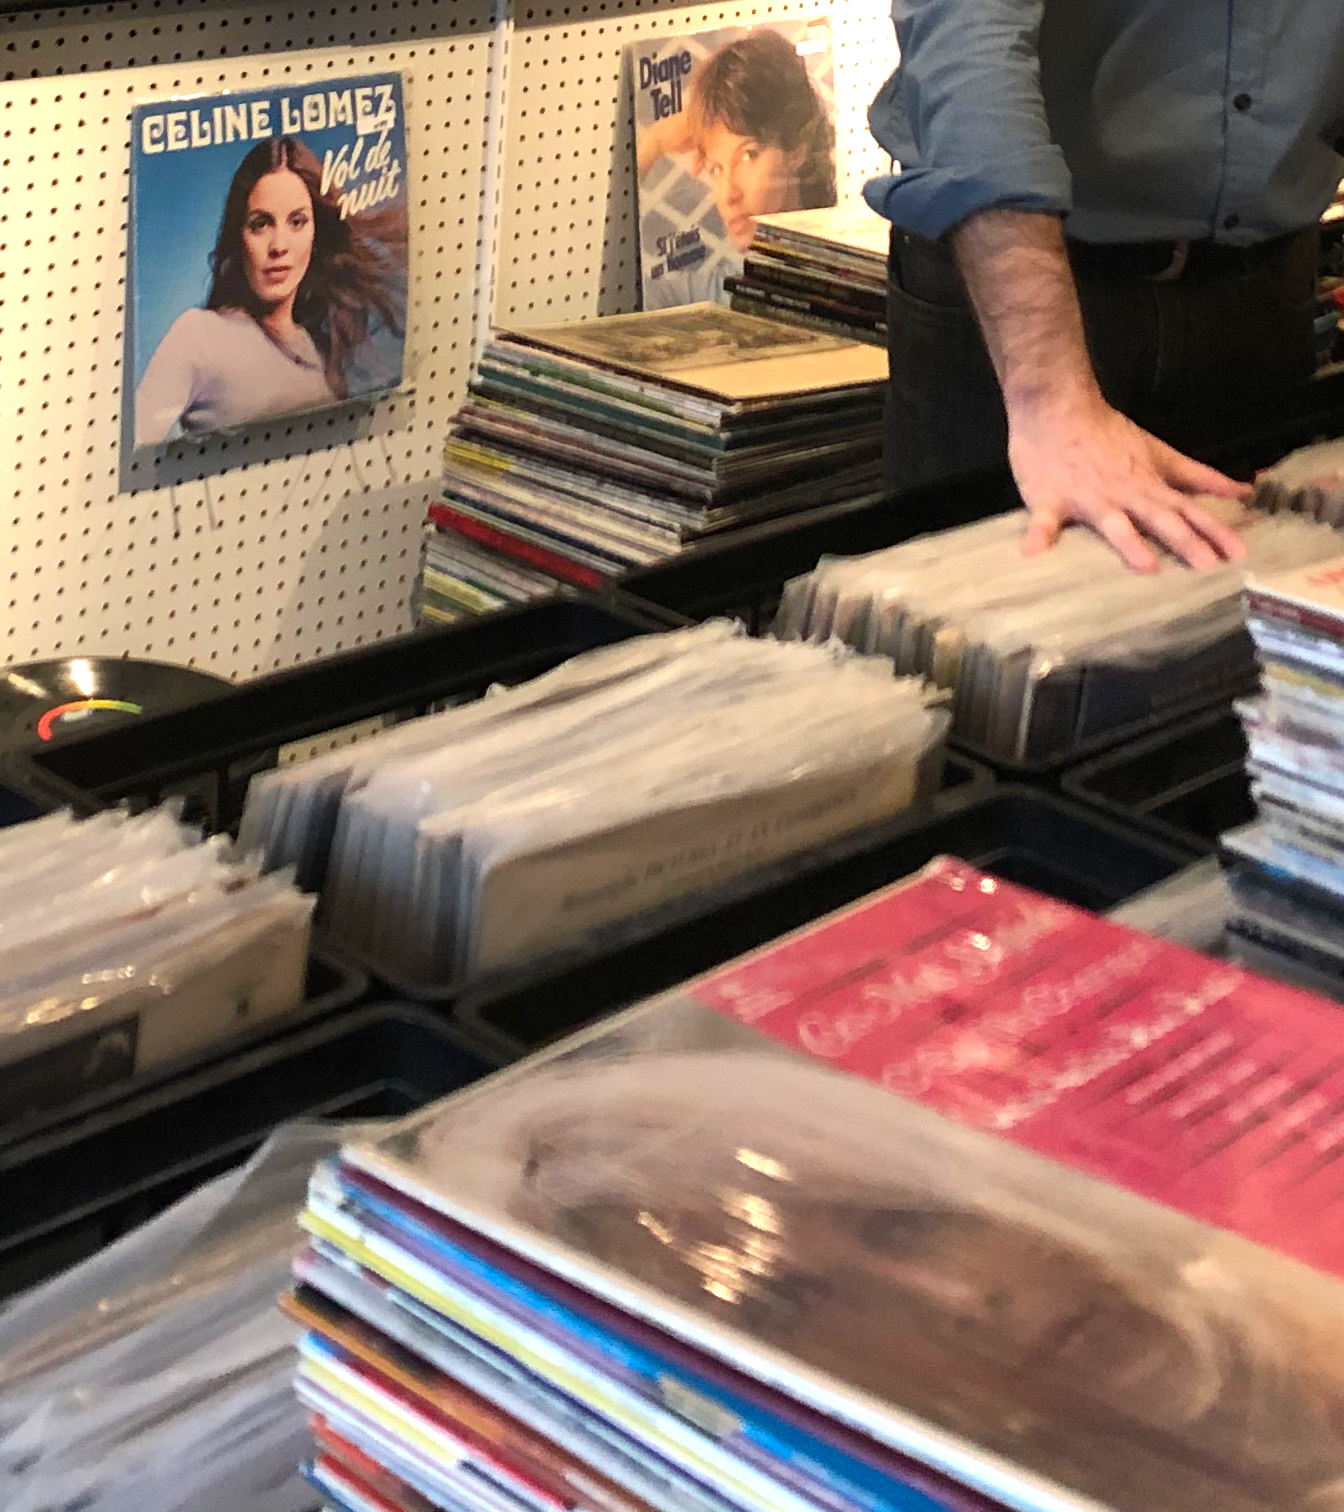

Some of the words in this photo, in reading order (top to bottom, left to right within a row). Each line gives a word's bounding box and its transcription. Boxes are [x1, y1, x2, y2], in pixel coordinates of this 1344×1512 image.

[638, 46, 692, 90] Diane
[141, 98, 274, 155] CELINE
[280, 82, 397, 137] LOMEZ
[649, 79, 684, 122] Tell
[319, 137, 367, 196] Vol
[364, 126, 392, 179] de
[335, 162, 402, 220] nuit
[651, 263, 664, 279] un
[667, 245, 706, 272] homme
[656, 236, 667, 256] Si
